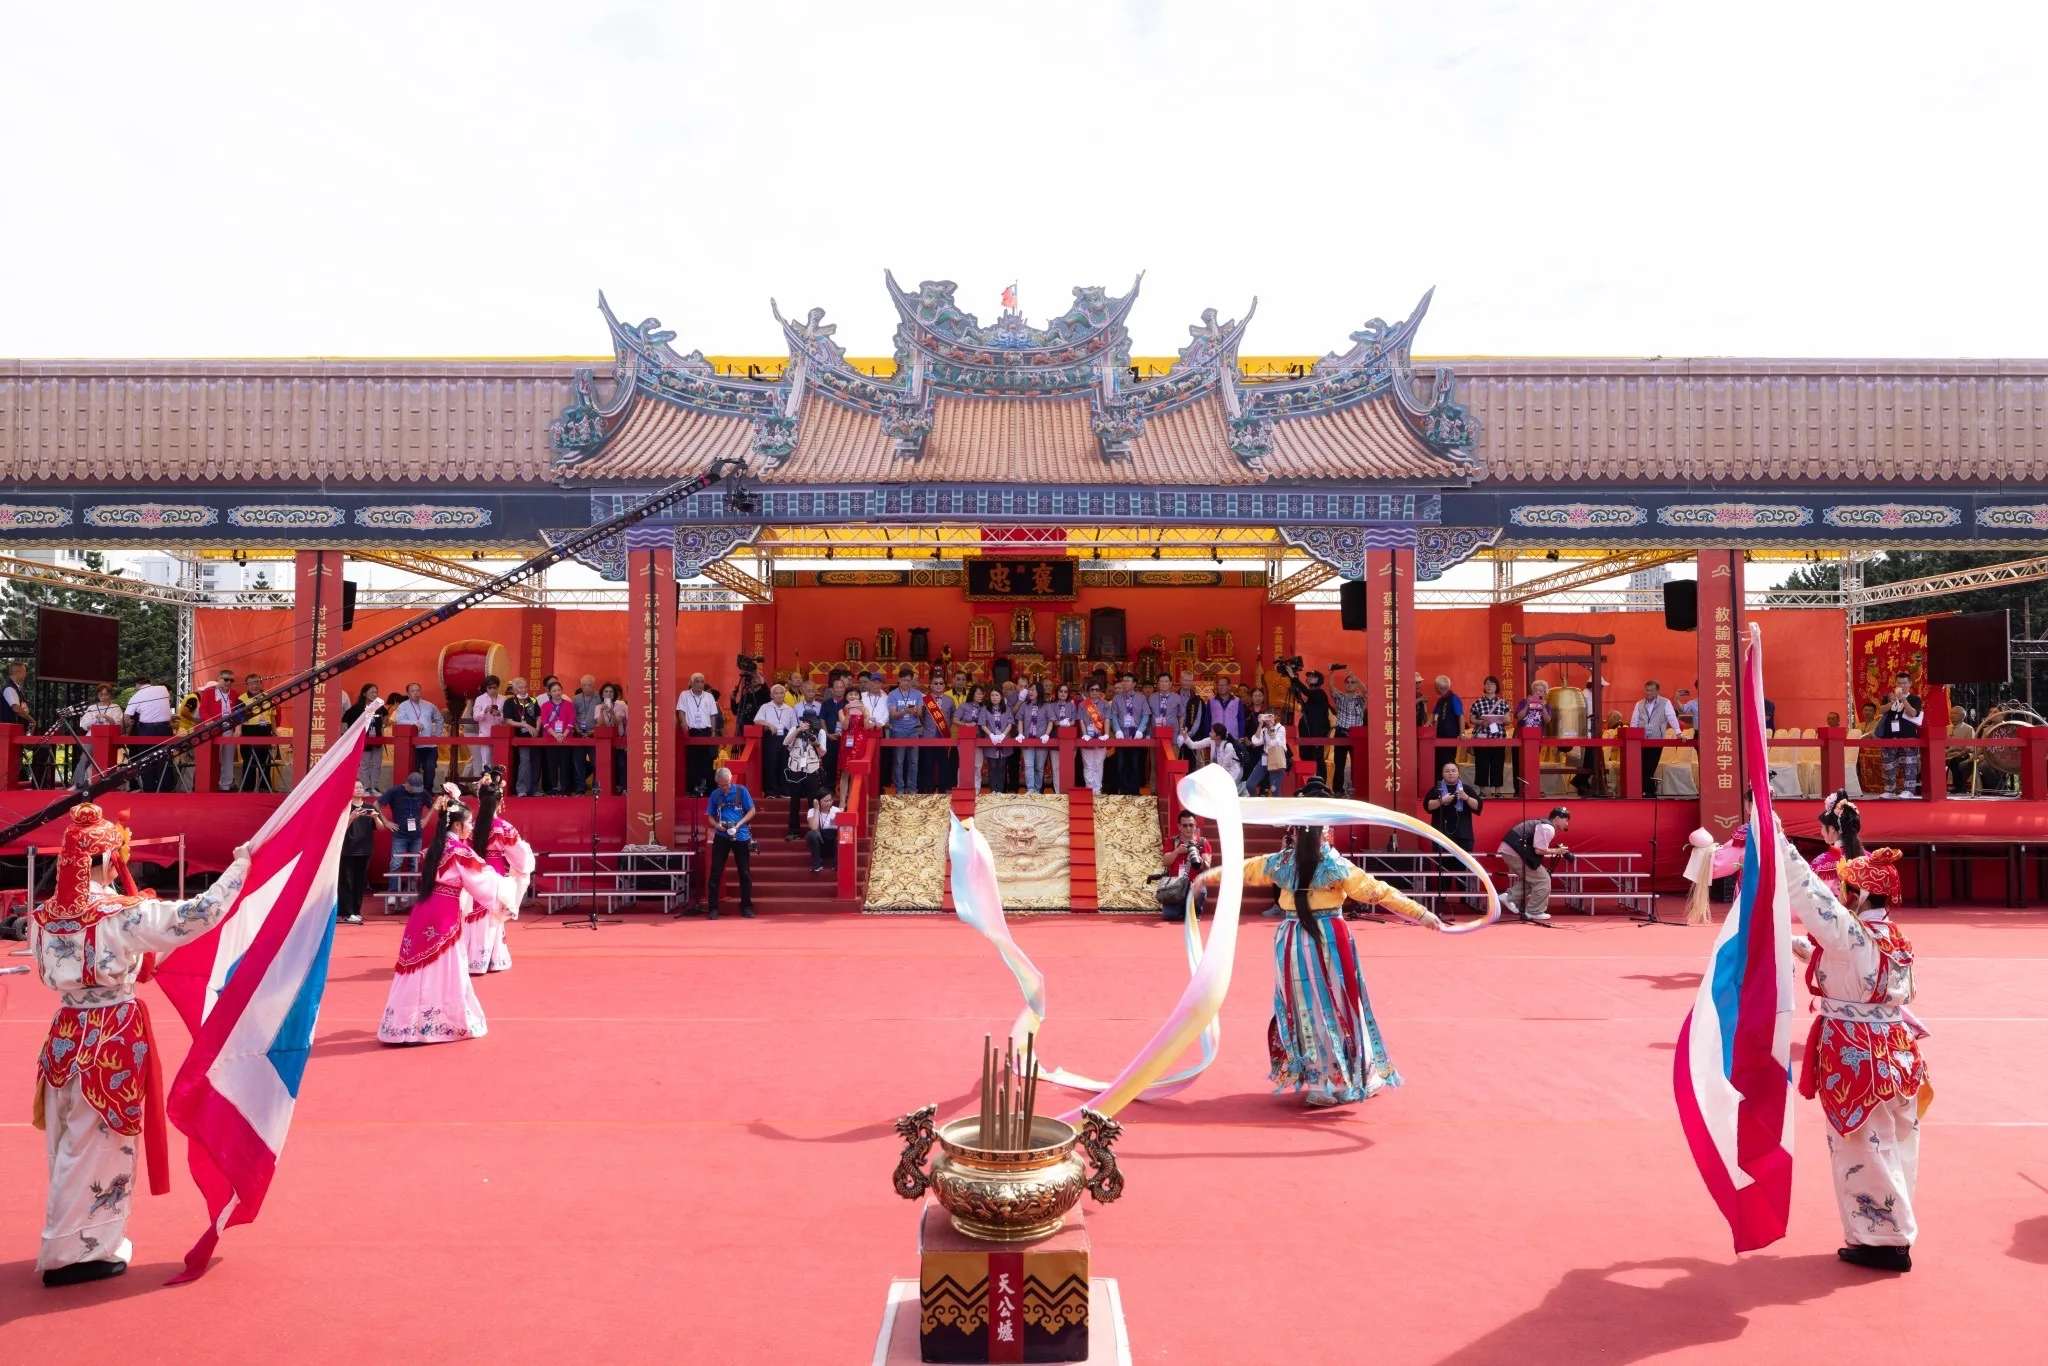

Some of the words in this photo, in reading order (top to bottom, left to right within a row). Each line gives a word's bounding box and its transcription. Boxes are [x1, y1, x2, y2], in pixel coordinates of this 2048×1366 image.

[988, 562, 1055, 594] 褒忠
[996, 1273, 1016, 1342] 天公爐
